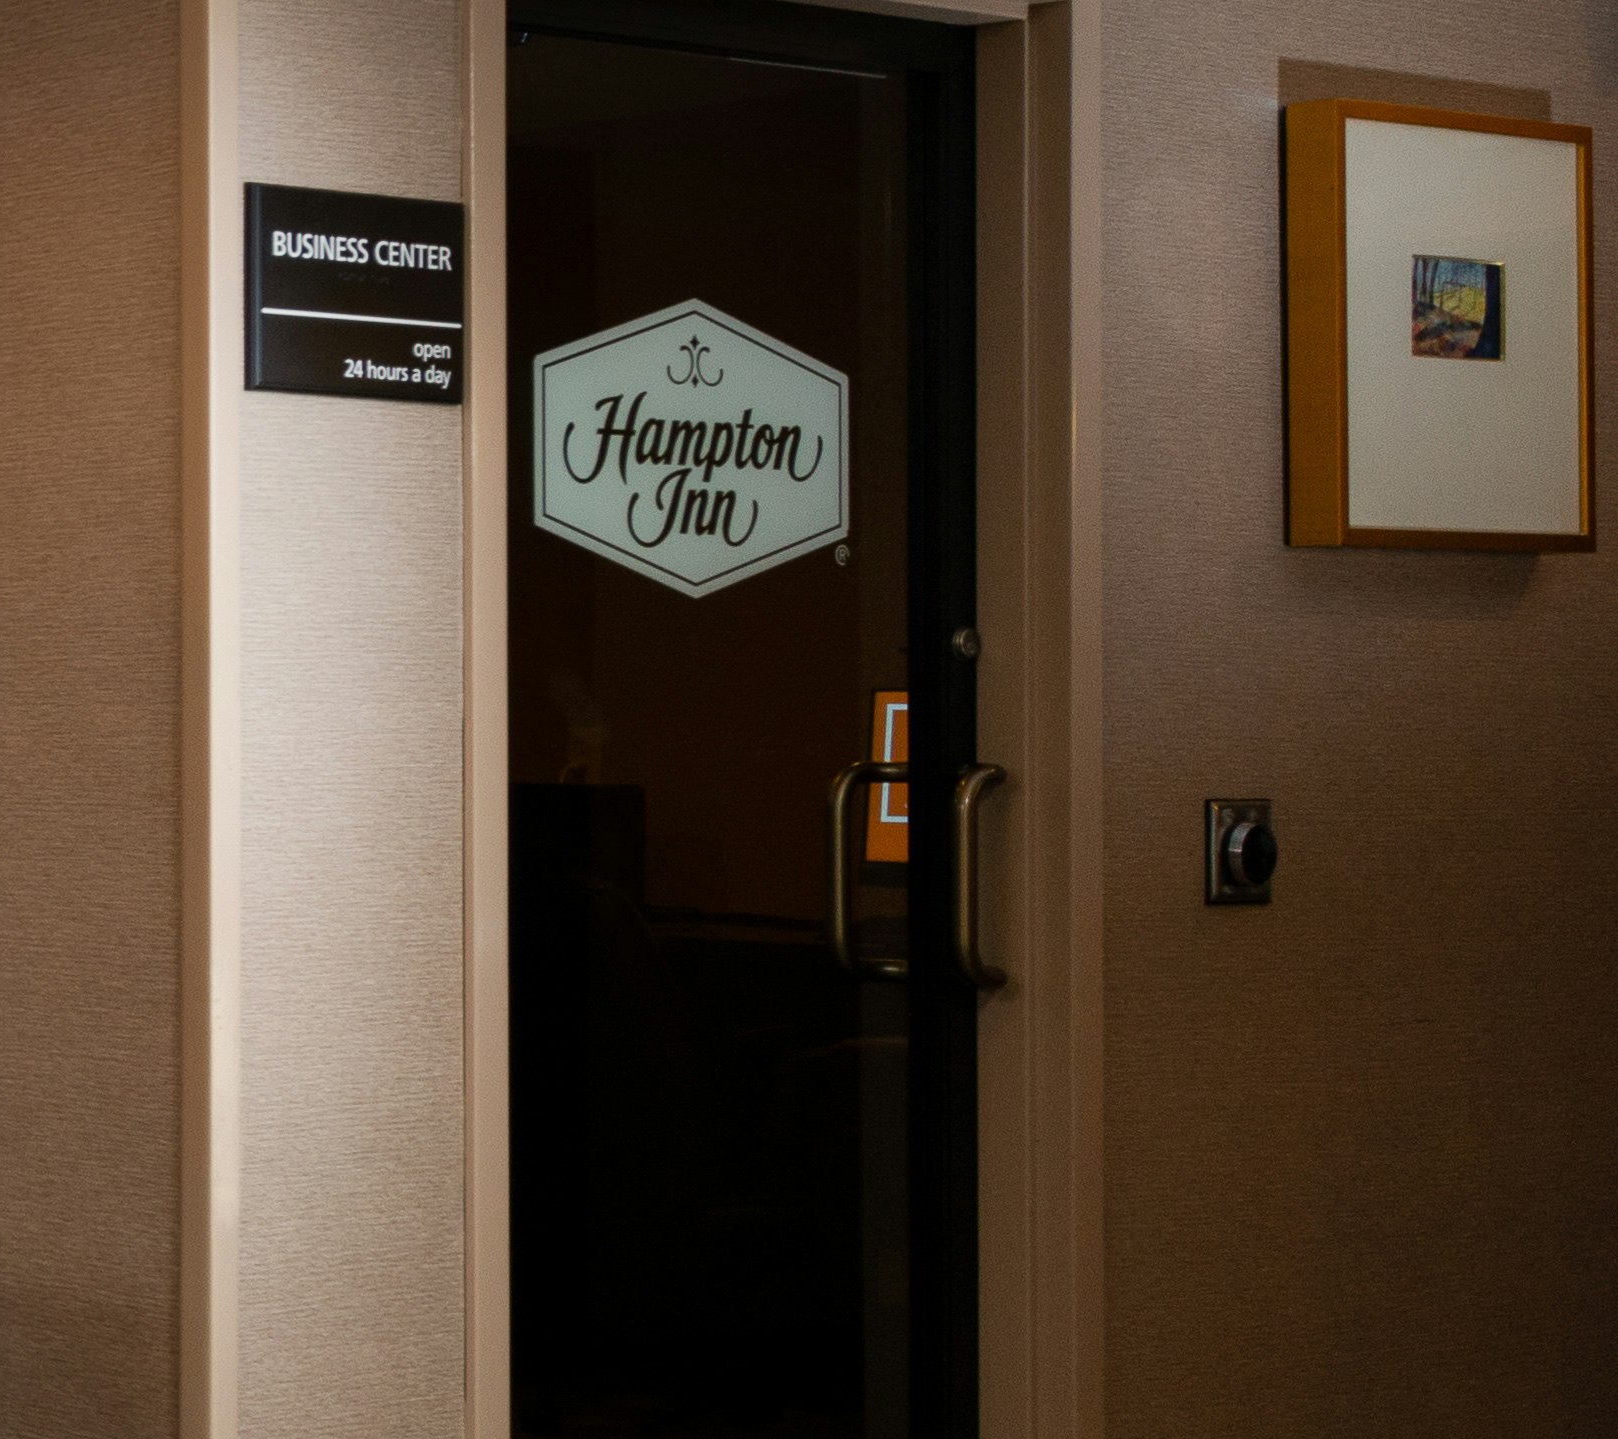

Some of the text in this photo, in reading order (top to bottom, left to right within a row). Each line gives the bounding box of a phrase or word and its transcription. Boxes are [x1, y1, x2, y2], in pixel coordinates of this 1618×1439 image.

[271, 230, 452, 271] BUSINESS CENTER
[413, 342, 451, 361] open
[344, 359, 452, 389] 24 hours a day
[562, 390, 824, 486] Hampton
[626, 467, 759, 548] Inn
